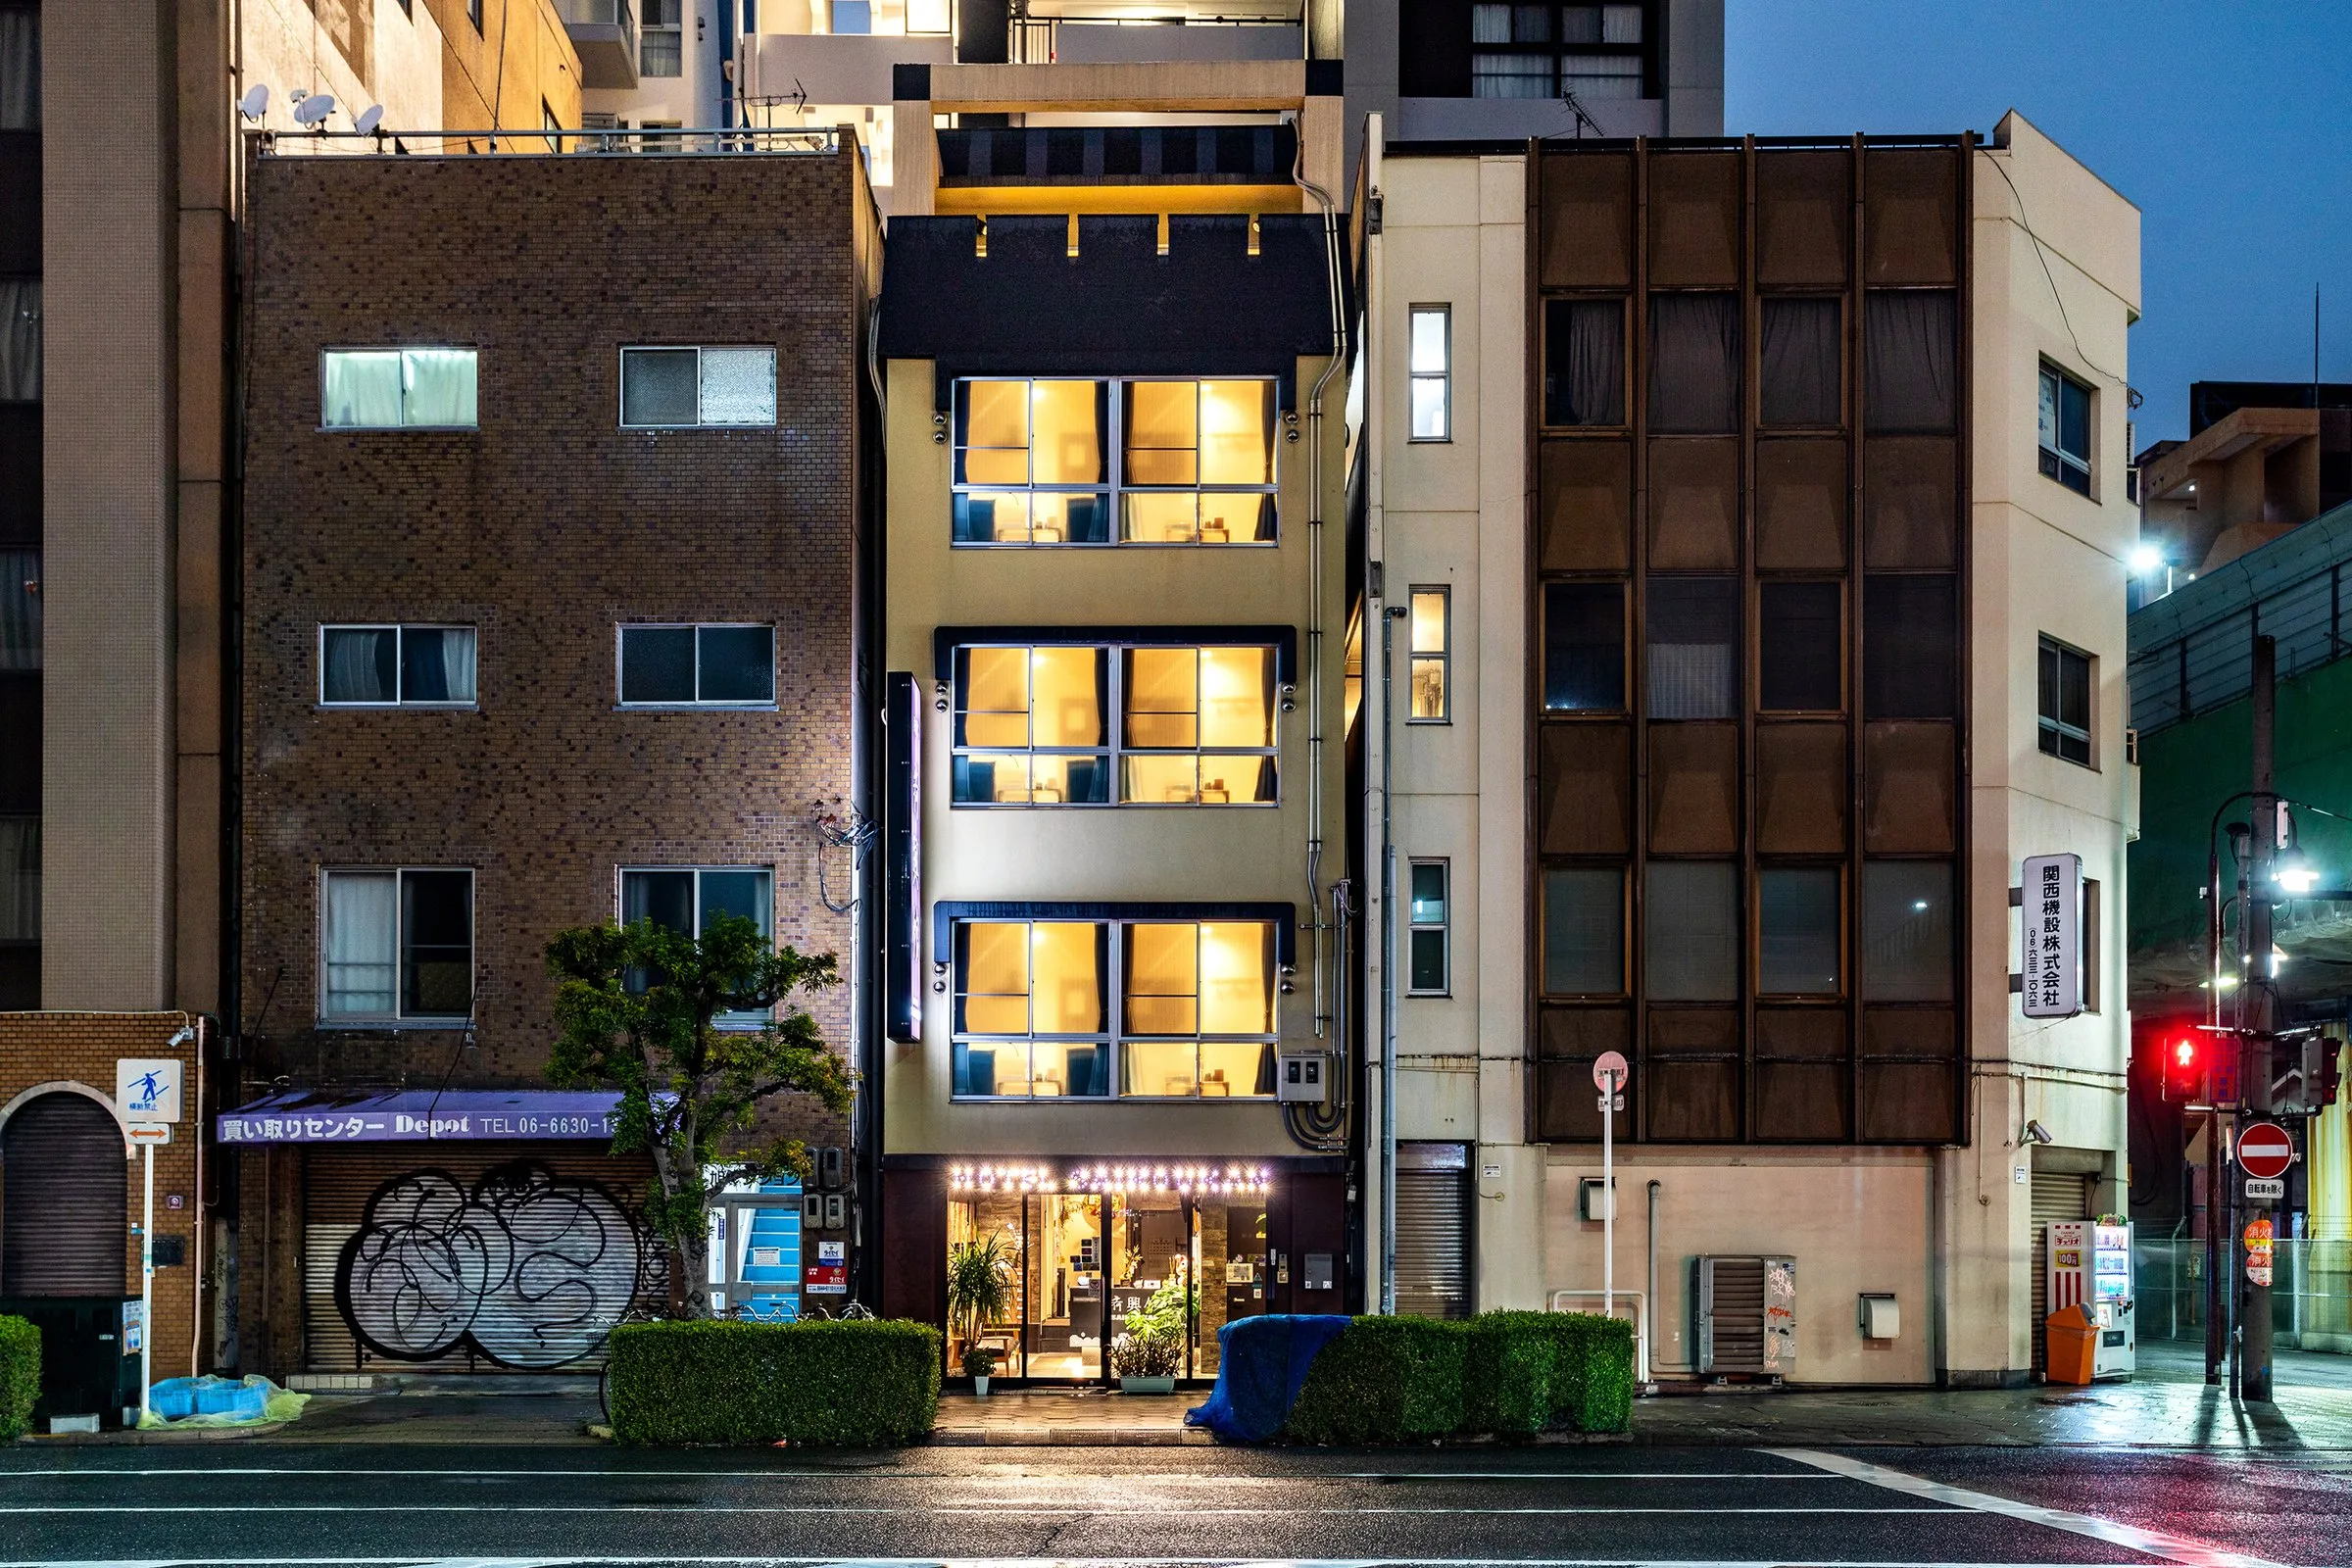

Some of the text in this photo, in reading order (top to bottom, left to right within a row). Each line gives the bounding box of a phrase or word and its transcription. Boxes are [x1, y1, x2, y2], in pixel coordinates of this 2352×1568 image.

[2042, 865, 2061, 1006] 関西機設株式会社
[223, 1117, 385, 1140] 買い取りセンター
[394, 1114, 471, 1138] Depot
[480, 1118, 515, 1133] TEL
[951, 1165, 1055, 1192] HOTEL
[2247, 1184, 2282, 1195] 自転車を除く
[2056, 1237, 2080, 1246] チェリオ
